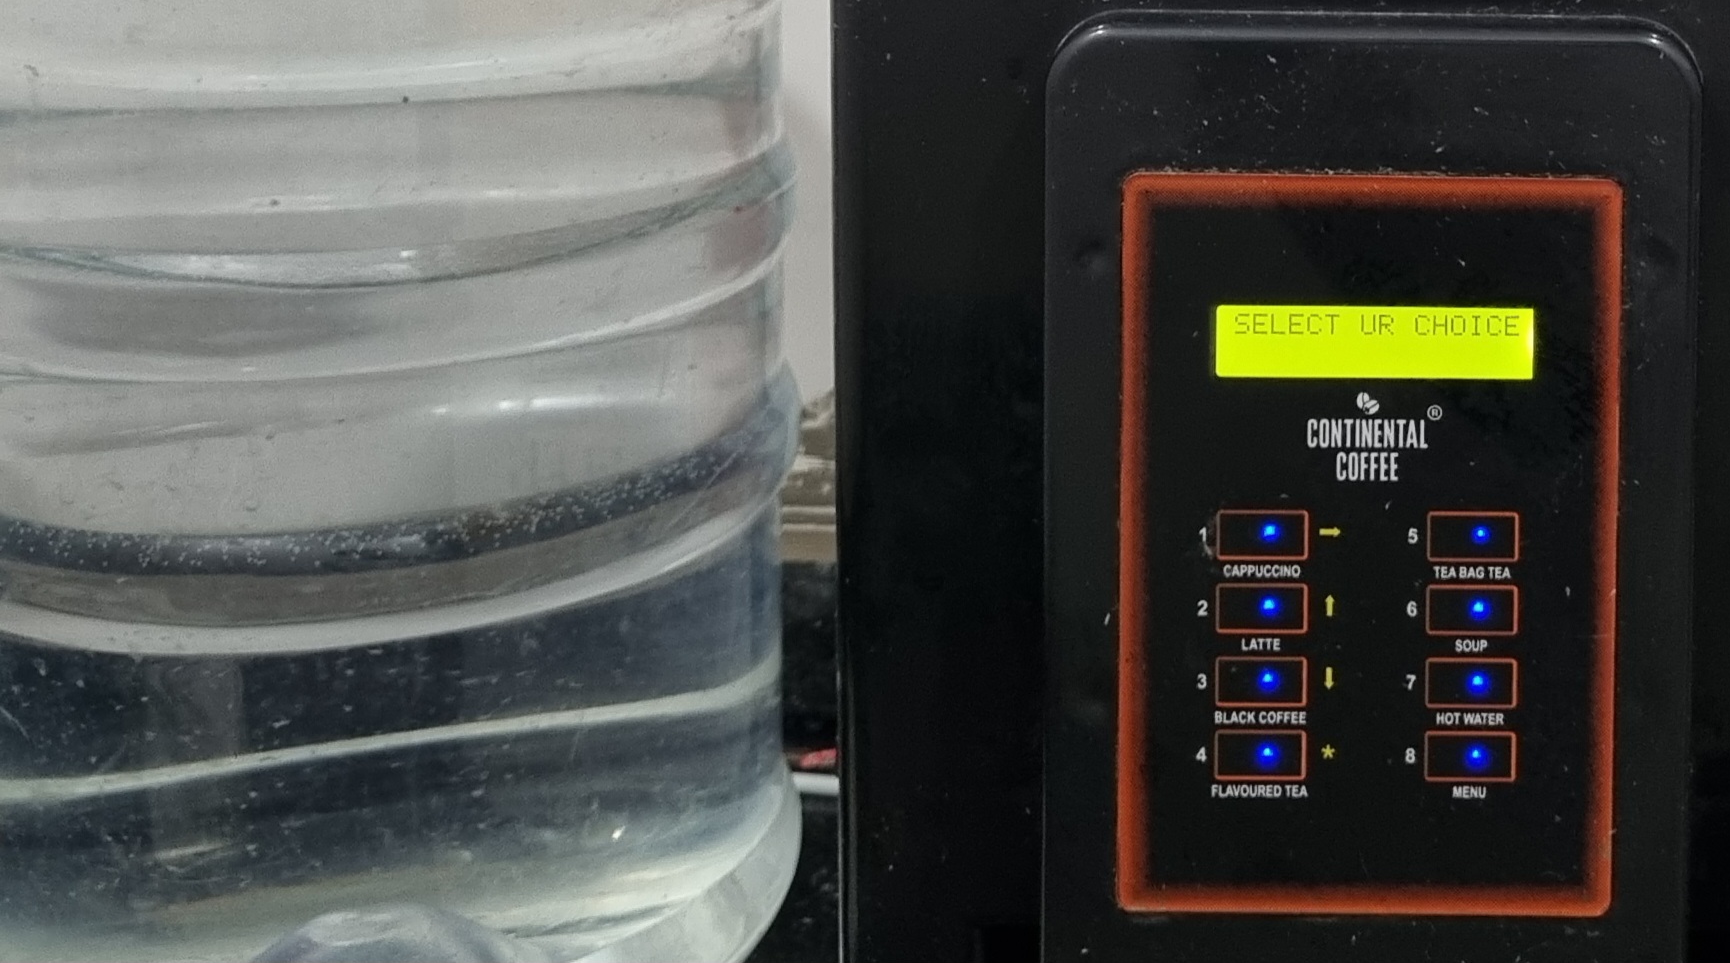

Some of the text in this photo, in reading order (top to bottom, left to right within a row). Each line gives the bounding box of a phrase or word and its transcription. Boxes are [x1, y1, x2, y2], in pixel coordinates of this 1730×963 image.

[1235, 313, 1520, 337] SELECT UR CHOICE
[1307, 418, 1428, 449] CONTINENTAL
[1336, 452, 1398, 481] COFFEE
[1199, 527, 1206, 542] 1
[1408, 528, 1418, 543] 5
[1223, 565, 1301, 578] CAPPUCCINO
[1433, 566, 1511, 579] TEA BAG TEA
[1198, 600, 1208, 616] 2
[1407, 601, 1417, 617] 6
[1242, 638, 1280, 651] LATTE
[1455, 639, 1487, 652] SOUP
[1198, 674, 1207, 689] 3
[1407, 674, 1416, 690] 7
[1215, 711, 1306, 724] BLACK COFFEE
[1436, 712, 1504, 725] HOT WATER
[1196, 747, 1206, 762] 4
[1405, 748, 1415, 763] 8
[1211, 784, 1308, 798] FLAVOURED TEA
[1453, 786, 1486, 798] MENU
